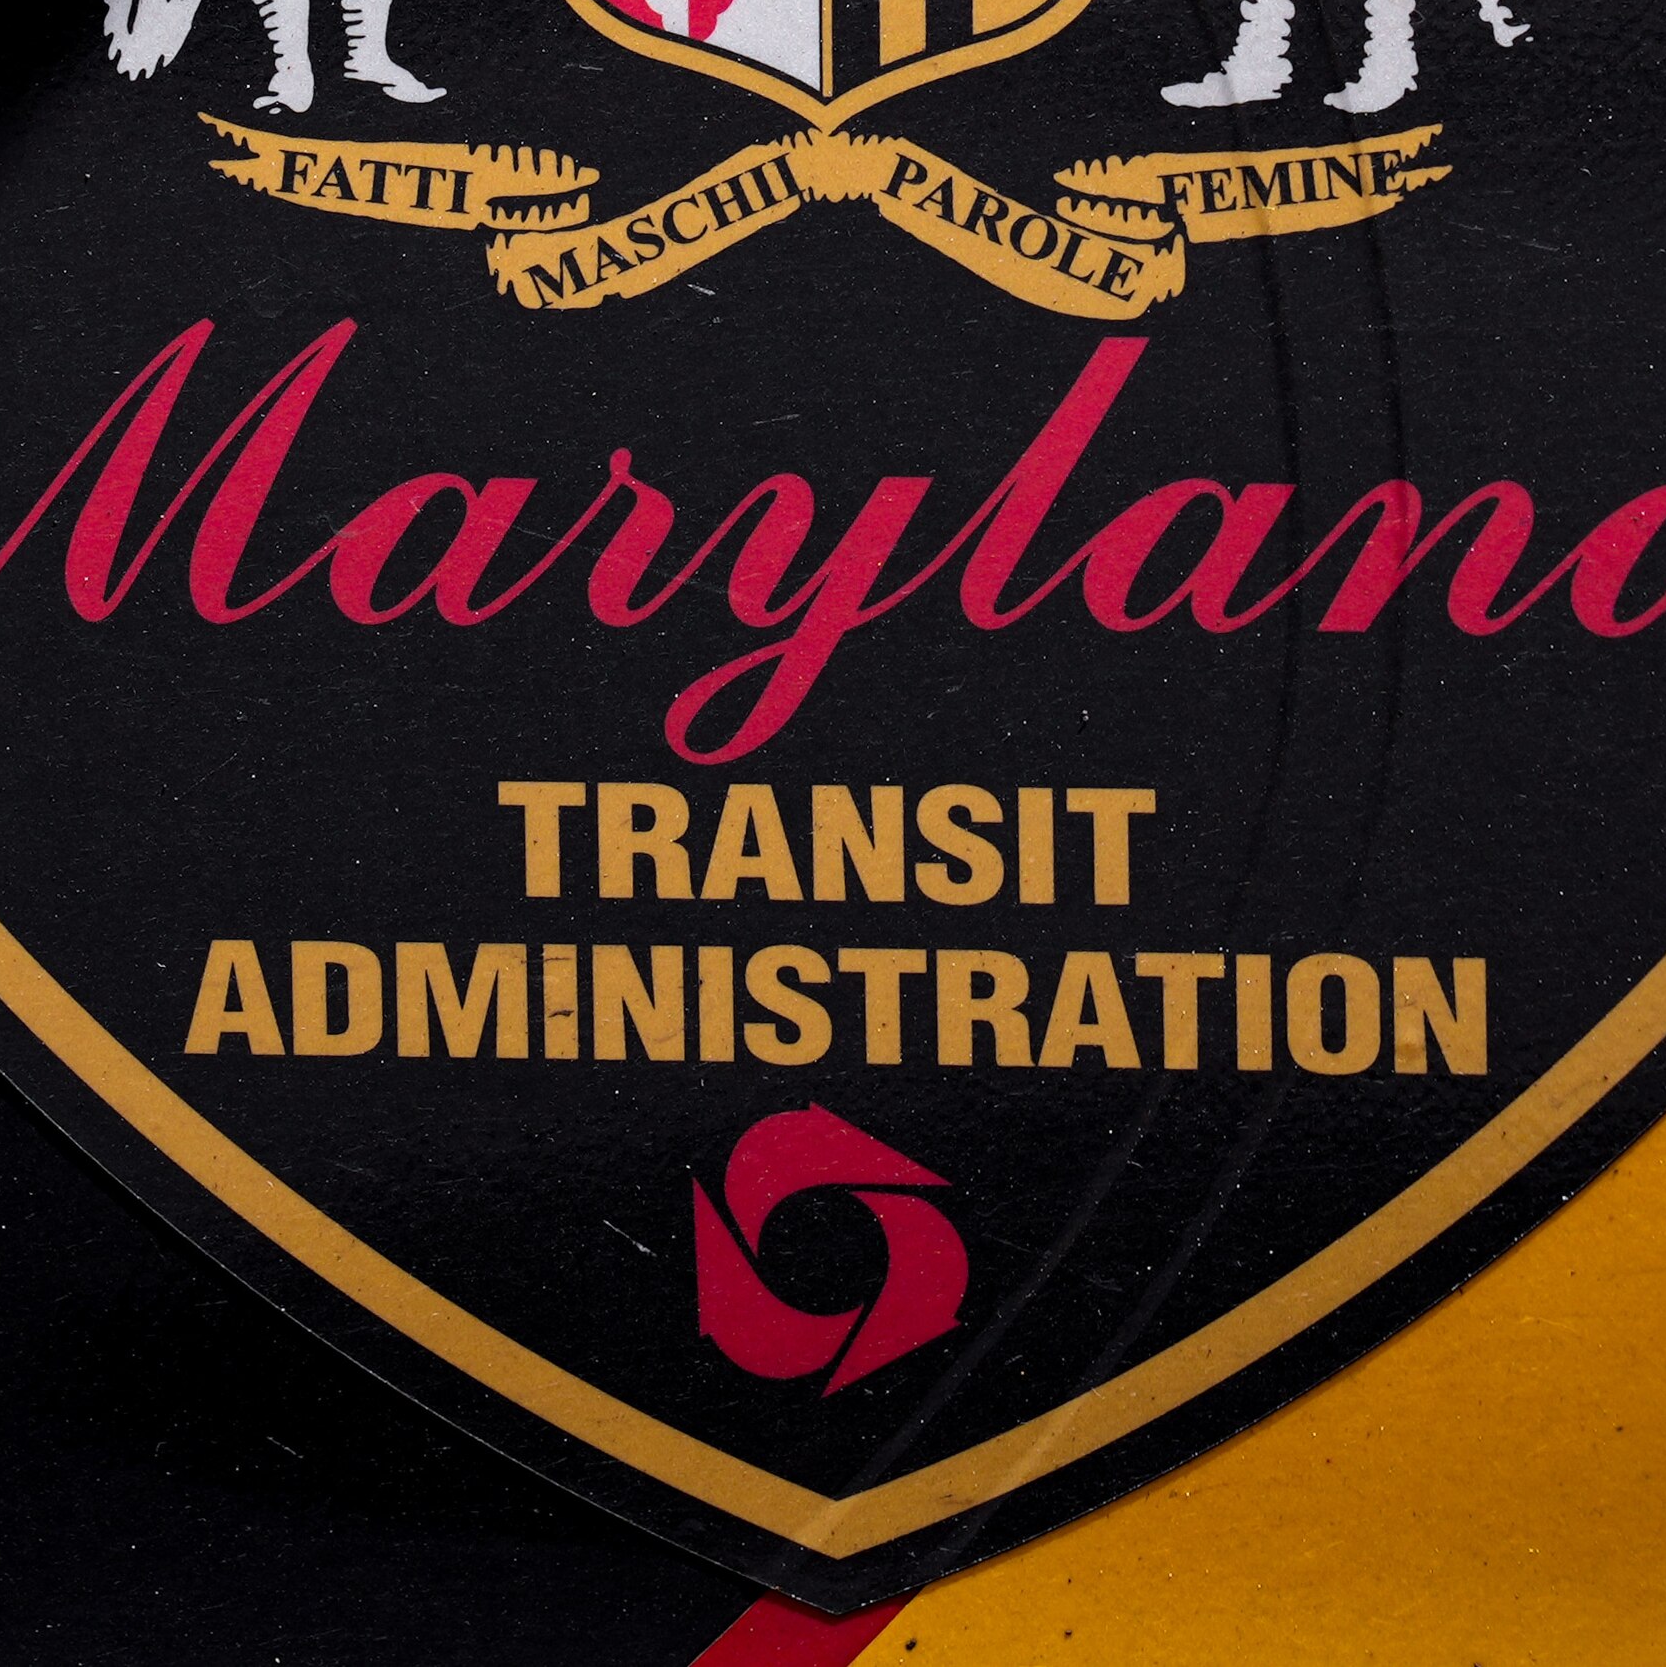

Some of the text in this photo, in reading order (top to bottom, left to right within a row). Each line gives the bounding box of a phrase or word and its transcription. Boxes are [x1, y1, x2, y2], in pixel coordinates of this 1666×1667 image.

[275, 149, 1406, 308] FATTI MASCHII PAROLE FEMINE
[498, 781, 1156, 907] TRANSIT
[183, 940, 1489, 1076] ADMINISTRATION
